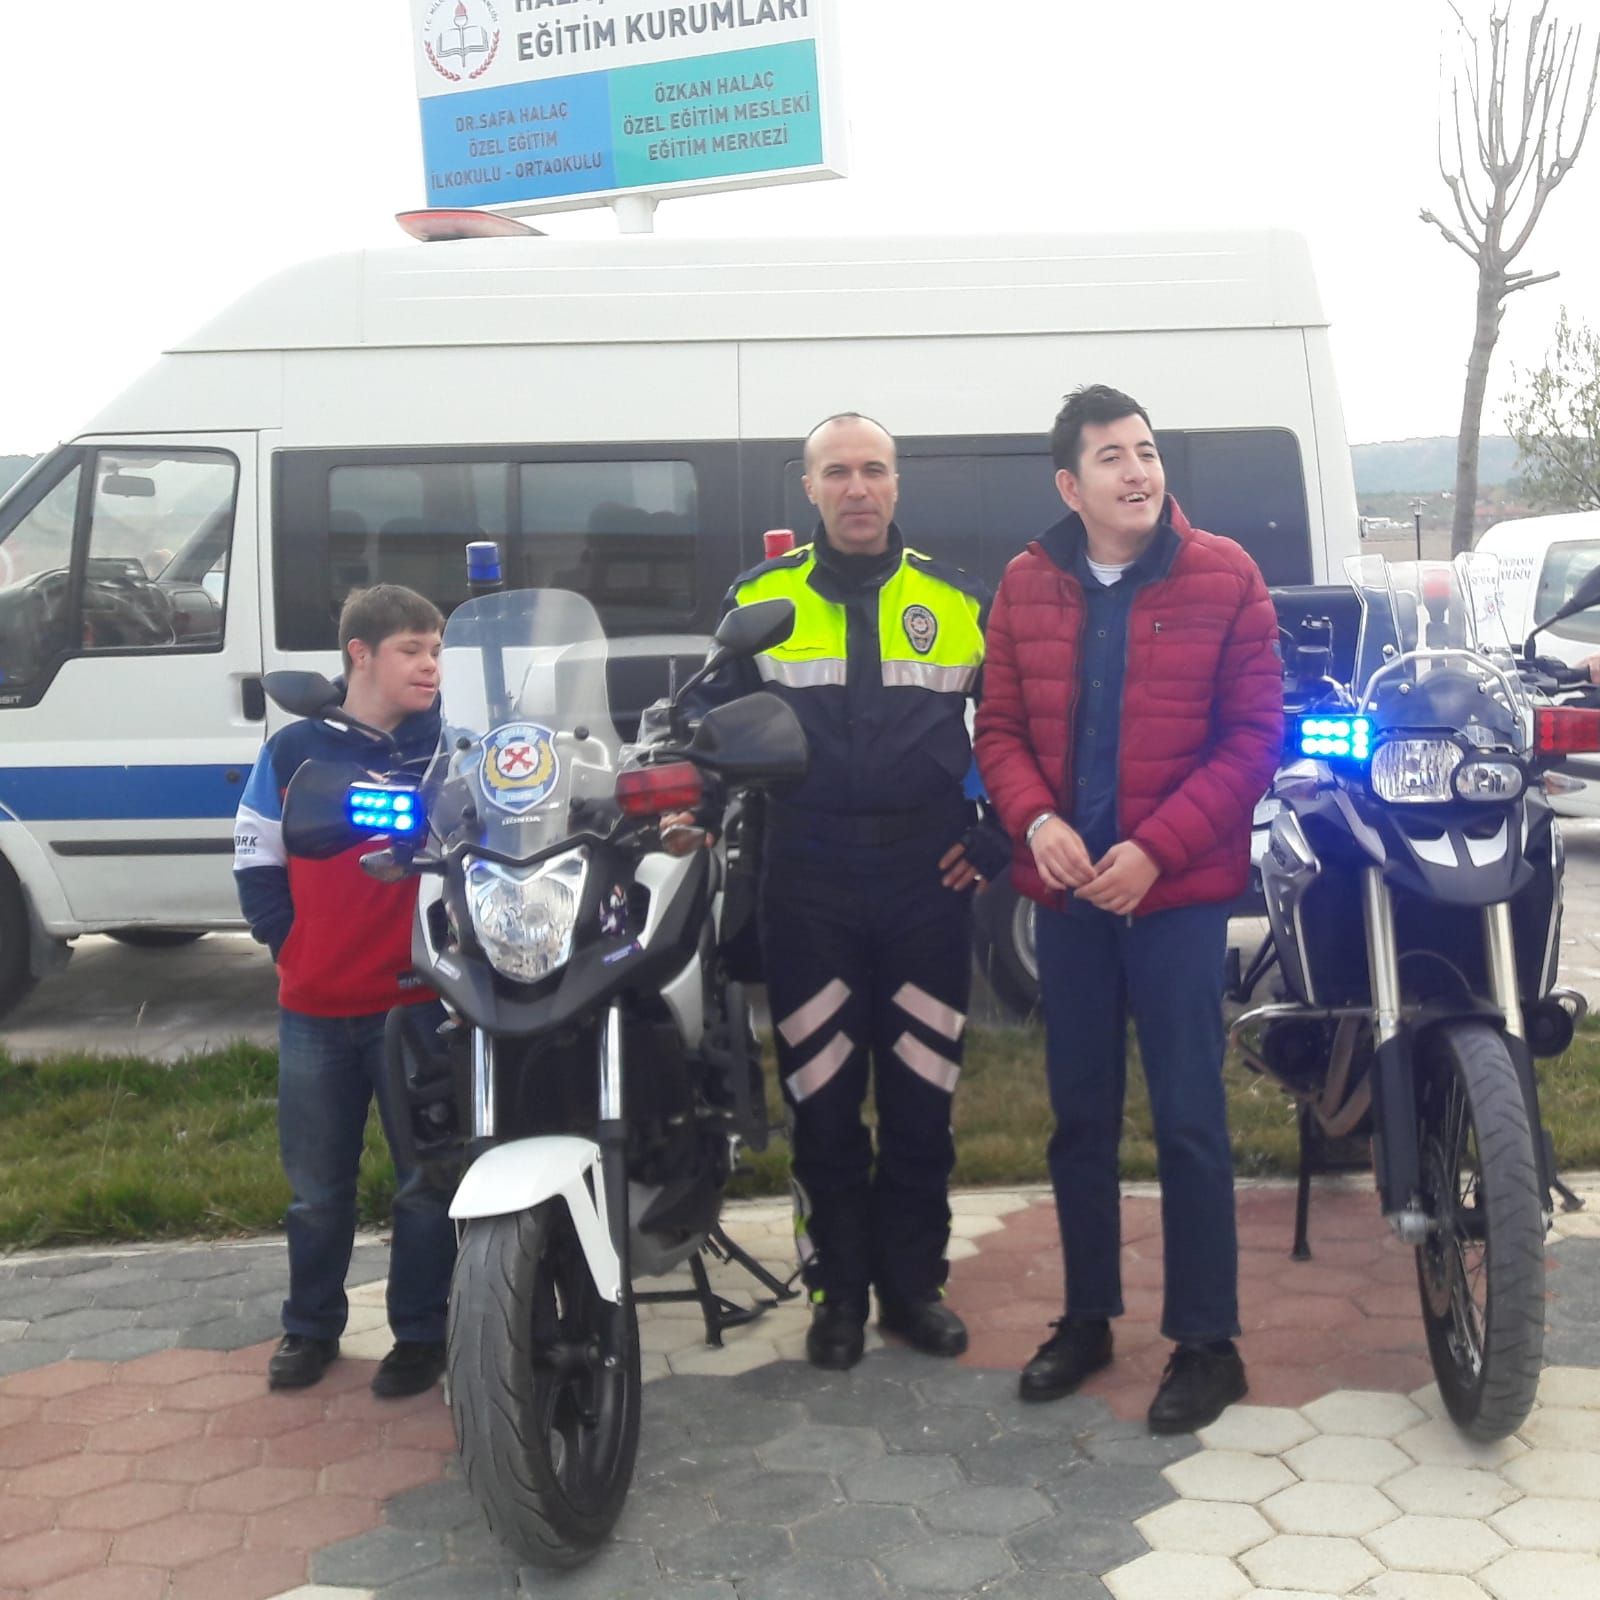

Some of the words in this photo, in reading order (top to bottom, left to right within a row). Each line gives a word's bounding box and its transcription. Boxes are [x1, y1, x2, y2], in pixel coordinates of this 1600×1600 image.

[517, 14, 616, 62] EĞİTİM
[625, 0, 808, 44] KURUMLARI
[655, 80, 711, 103] ÖZKAN
[717, 71, 775, 95] HALAÇ
[519, 102, 568, 123] HALAÇ
[623, 115, 665, 135] ÖZEL
[670, 104, 728, 129] EĞİTİM
[734, 91, 810, 121] MESLEKİ
[469, 138, 504, 157] ÖZEL
[508, 130, 558, 152] EĞİTİM
[649, 136, 706, 160] EĞİTİM
[713, 123, 788, 152] MERKEZİ
[431, 167, 501, 189] İLKOKULU
[515, 152, 602, 178] ORTAOKULU
